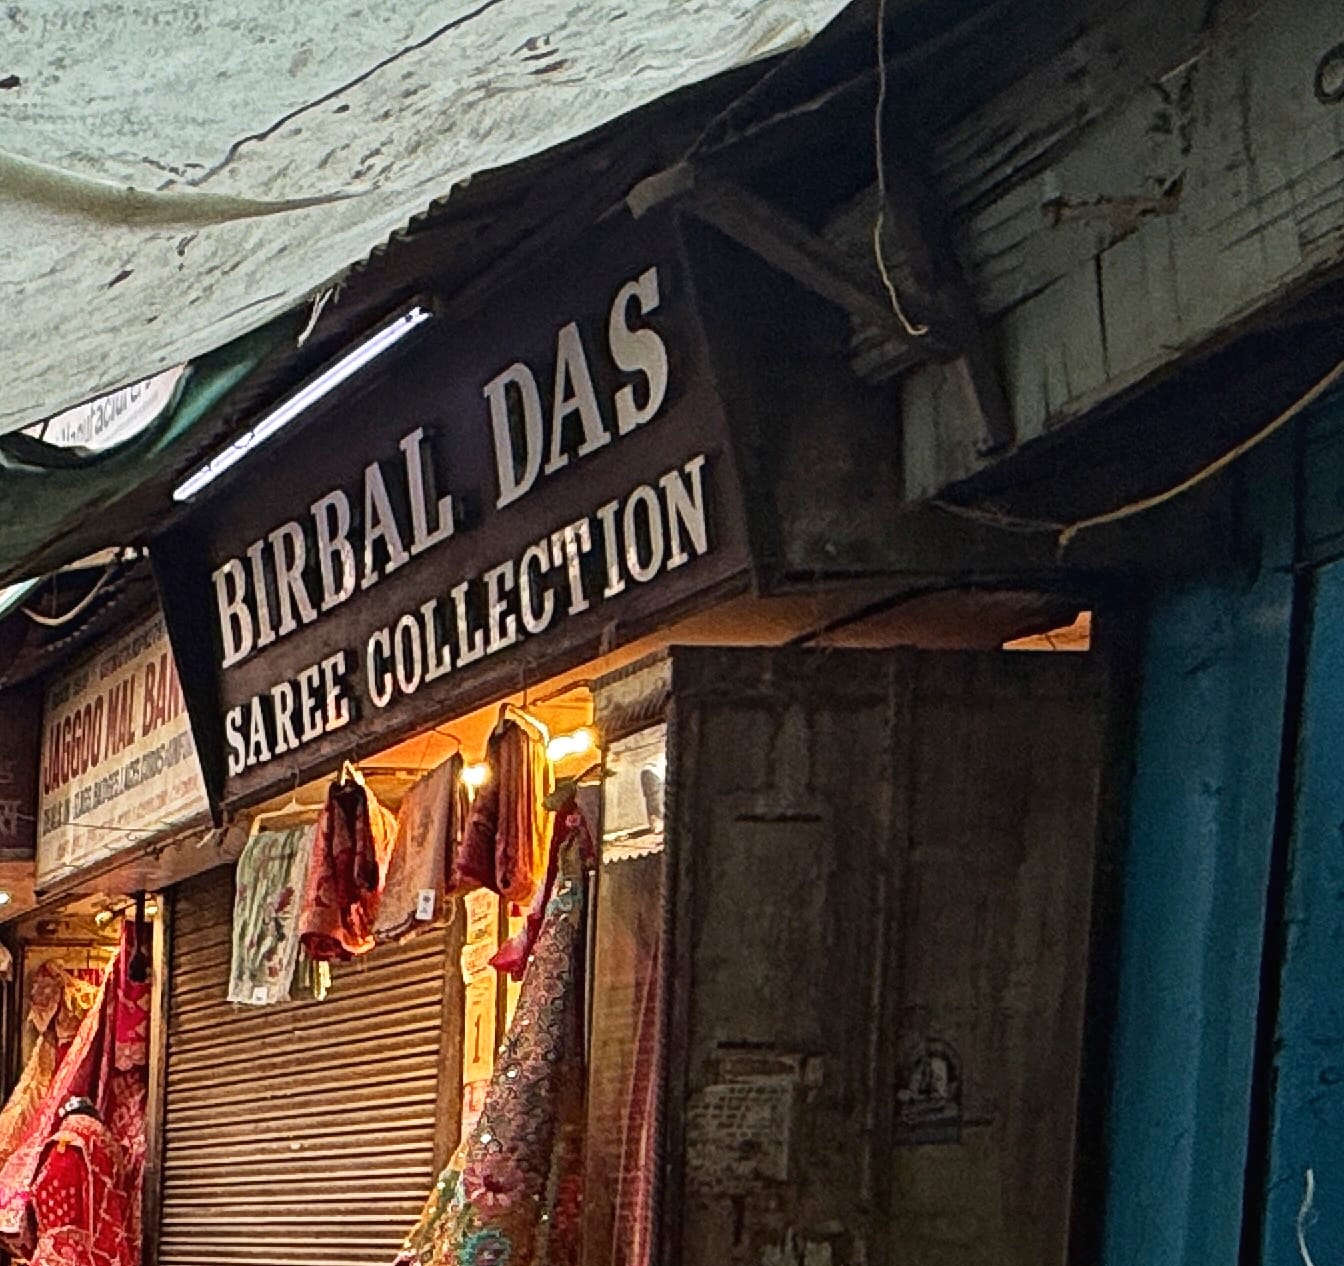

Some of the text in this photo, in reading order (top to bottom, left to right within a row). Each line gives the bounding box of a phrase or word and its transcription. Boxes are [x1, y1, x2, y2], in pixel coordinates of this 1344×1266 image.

[212, 266, 669, 669] BIRBAL DAS
[225, 650, 350, 776] SAREE
[367, 455, 708, 708] COLLECTION
